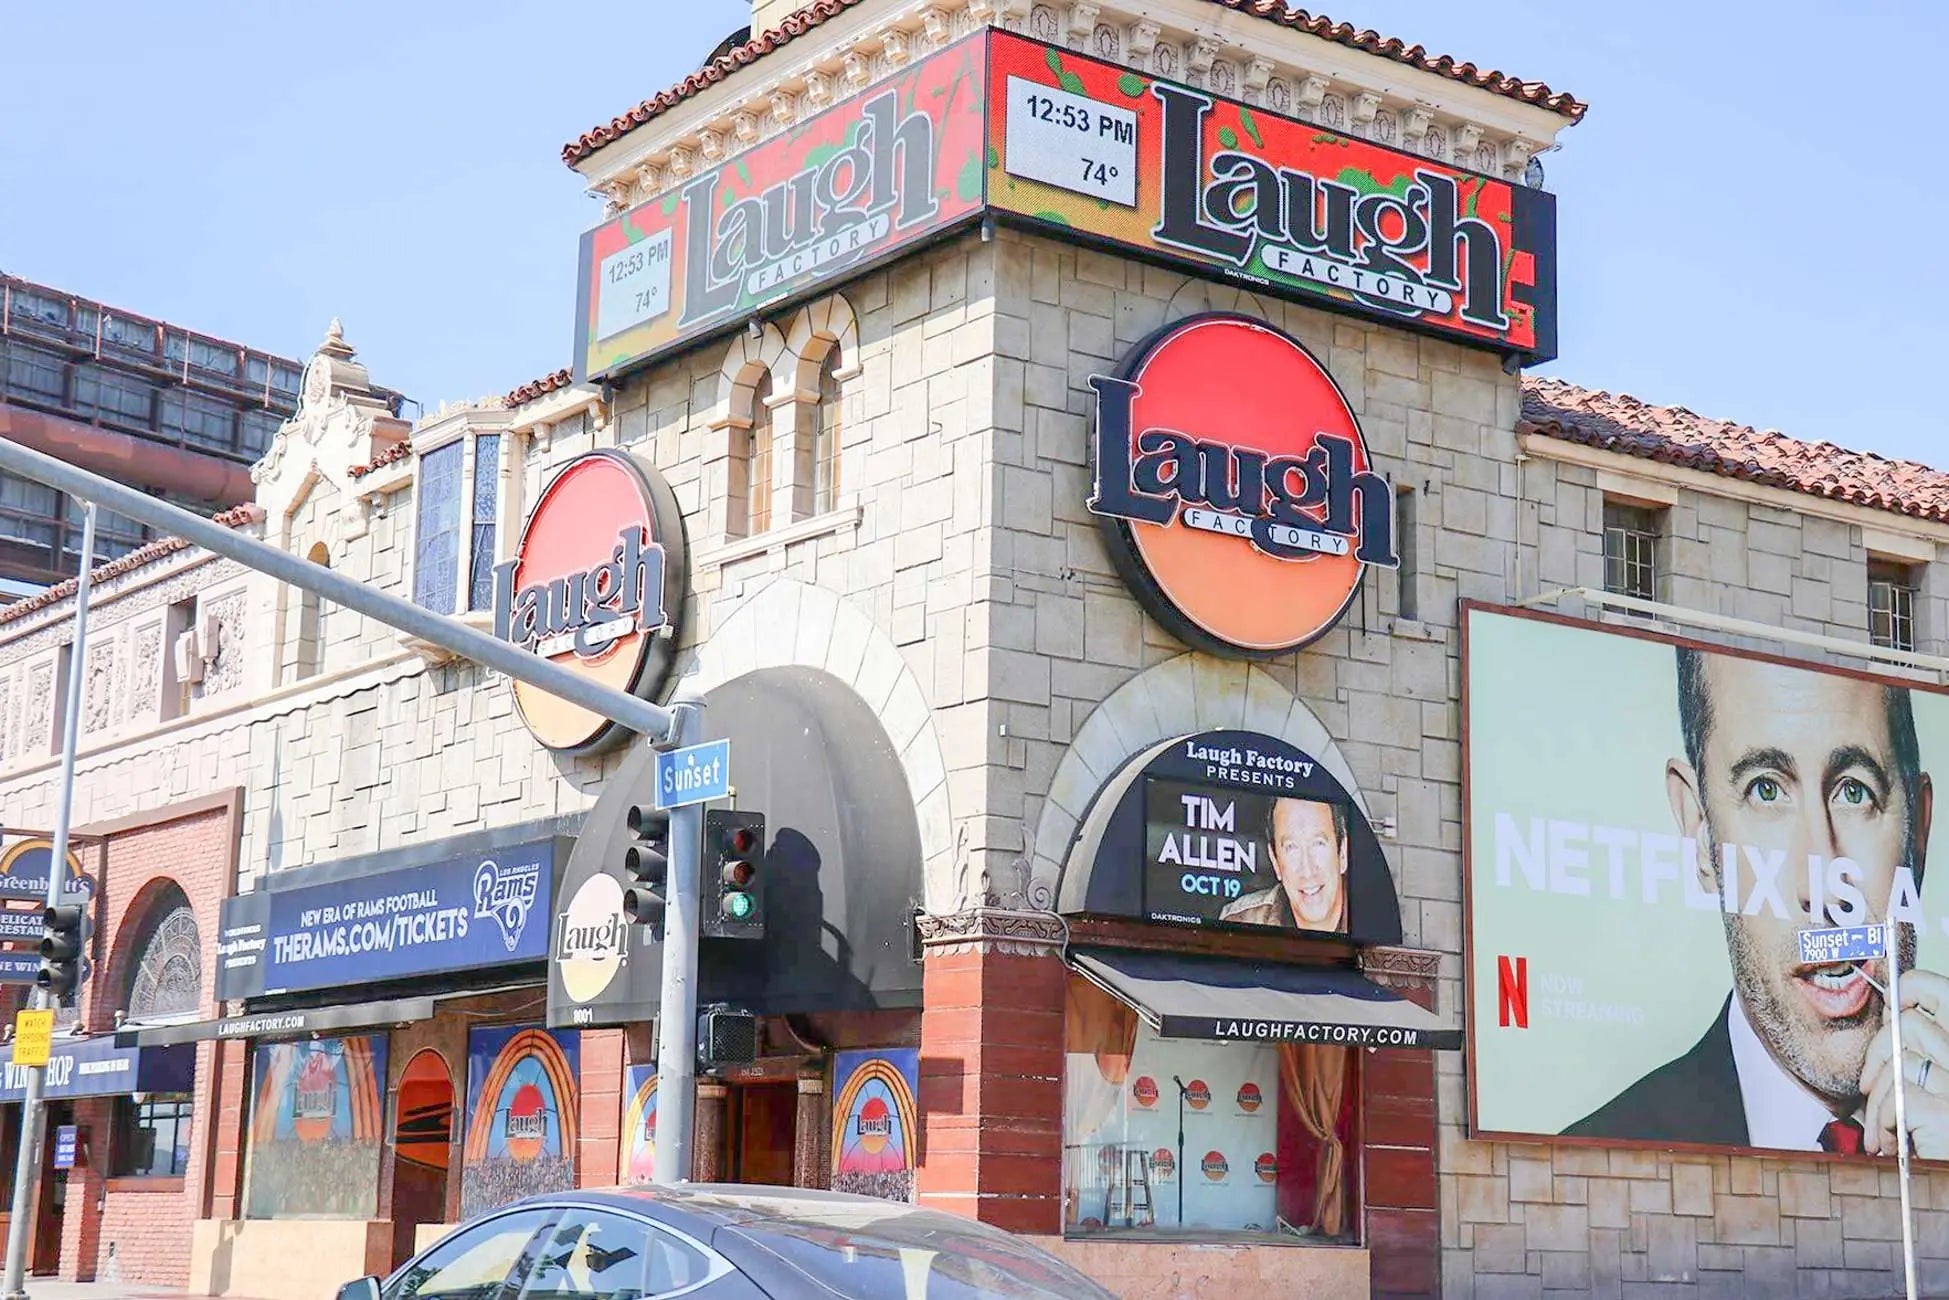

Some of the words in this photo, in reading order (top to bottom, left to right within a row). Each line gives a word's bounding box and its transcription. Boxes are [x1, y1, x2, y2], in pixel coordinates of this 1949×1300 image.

[1026, 95, 1091, 133] 12:53
[1098, 113, 1133, 146] PM
[1080, 158, 1119, 187] 74°
[679, 89, 937, 327] Laugh
[1150, 81, 1510, 332] Laugh
[609, 252, 643, 284] 12:53
[648, 240, 668, 266] PM
[758, 221, 882, 290] FACTORY
[1224, 267, 1270, 287] DAKTRONICS
[1277, 250, 1440, 310] FACTORY
[635, 286, 657, 312] 74°
[1086, 373, 1400, 569] Laugh
[1190, 510, 1344, 554] FACTORY
[540, 616, 630, 652] FACORY
[663, 756, 720, 794] Sunset
[1186, 741, 1242, 768] Laugh
[1246, 749, 1314, 777] Factory
[1206, 765, 1295, 789] PRESENTS
[1181, 793, 1236, 833] TIM
[1157, 831, 1257, 874] ALLEN
[474, 860, 539, 918] Rams
[1181, 873, 1220, 897] OCT
[1223, 878, 1242, 899] 19
[1495, 812, 1792, 921] NETFLIX
[1807, 854, 1867, 927] IS
[1886, 866, 1927, 937] A
[301, 908, 321, 928] NEW
[322, 906, 341, 925] ERA
[342, 903, 357, 921] OF
[357, 898, 385, 919] RAMS
[386, 889, 438, 915] FOOTBALL
[1151, 912, 1202, 925] DAKTRONICS
[273, 906, 469, 964] THERAMS.COM/TICKETS
[555, 911, 630, 963] Laugh
[1802, 931, 1849, 950] Sunset
[1804, 948, 1828, 961] 7900
[1831, 948, 1839, 959] W
[1497, 954, 1529, 1029] N
[1539, 973, 1585, 995] NOW
[218, 1015, 305, 1036] LAUGHFACTORY.COM
[573, 1007, 593, 1023] 8001
[1541, 998, 1647, 1026] STREAMING
[1215, 1020, 1418, 1046] LAUGHFACTORY.COM
[5, 1062, 29, 1090] WIN
[45, 1055, 75, 1087] HOP
